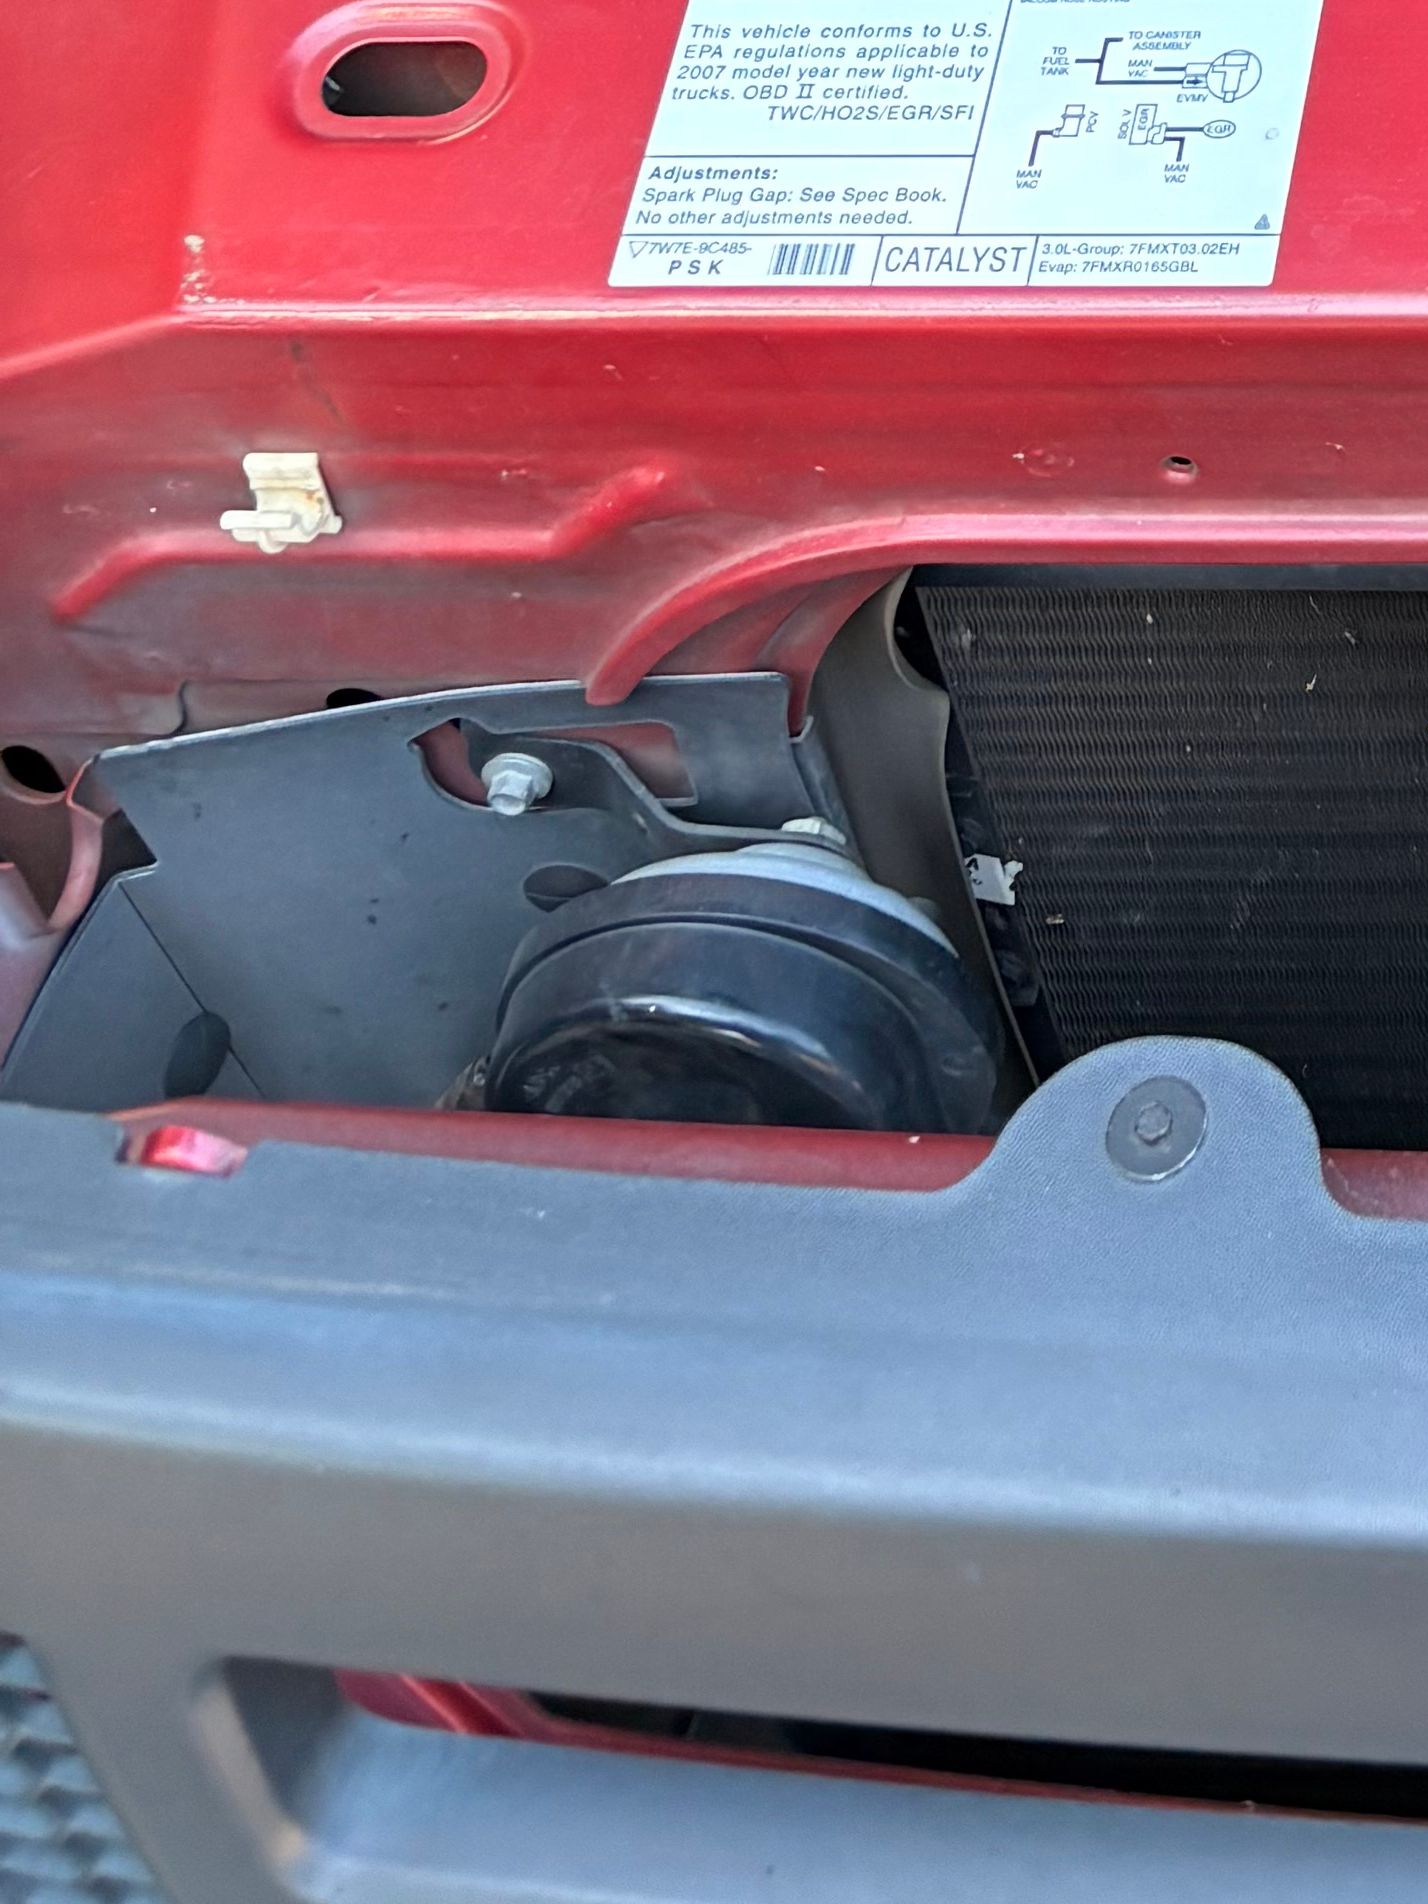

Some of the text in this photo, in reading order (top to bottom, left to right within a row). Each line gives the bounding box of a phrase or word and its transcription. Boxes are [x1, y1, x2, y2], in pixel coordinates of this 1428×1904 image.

[691, 23, 992, 38] This vehicle conforms to U.S.
[1129, 31, 1201, 39] TO CANISTER
[684, 44, 988, 62] EPA regulations applicable to
[1052, 47, 1066, 55] TO
[1133, 42, 1191, 50] ASSEMBLY
[1042, 57, 1070, 65] FUEL
[1128, 59, 1152, 67] MAN
[677, 65, 984, 82] 2007 model year new light-duty
[1041, 67, 1069, 75] TANK
[672, 86, 735, 100] trucks.
[743, 85, 787, 99] OBD
[823, 85, 909, 99] certified.
[768, 105, 974, 120] TWC/HO2S/EGR/SFI
[1086, 111, 1099, 132] PCV
[648, 167, 778, 183] Adjustments:
[1017, 170, 1042, 178] MAN
[1165, 164, 1189, 172] MAN
[1017, 180, 1038, 188] VAC
[1165, 175, 1186, 183] VAC
[642, 188, 947, 205] Spark Plug Gap: See Spec Book.
[636, 210, 913, 228] No other adjustments needed.
[1042, 243, 1240, 257] 3.0L-Group: 7FMXT03.02EH
[885, 247, 1027, 272] CATALYST
[668, 259, 723, 275] P S K
[1039, 261, 1077, 275] Evap:
